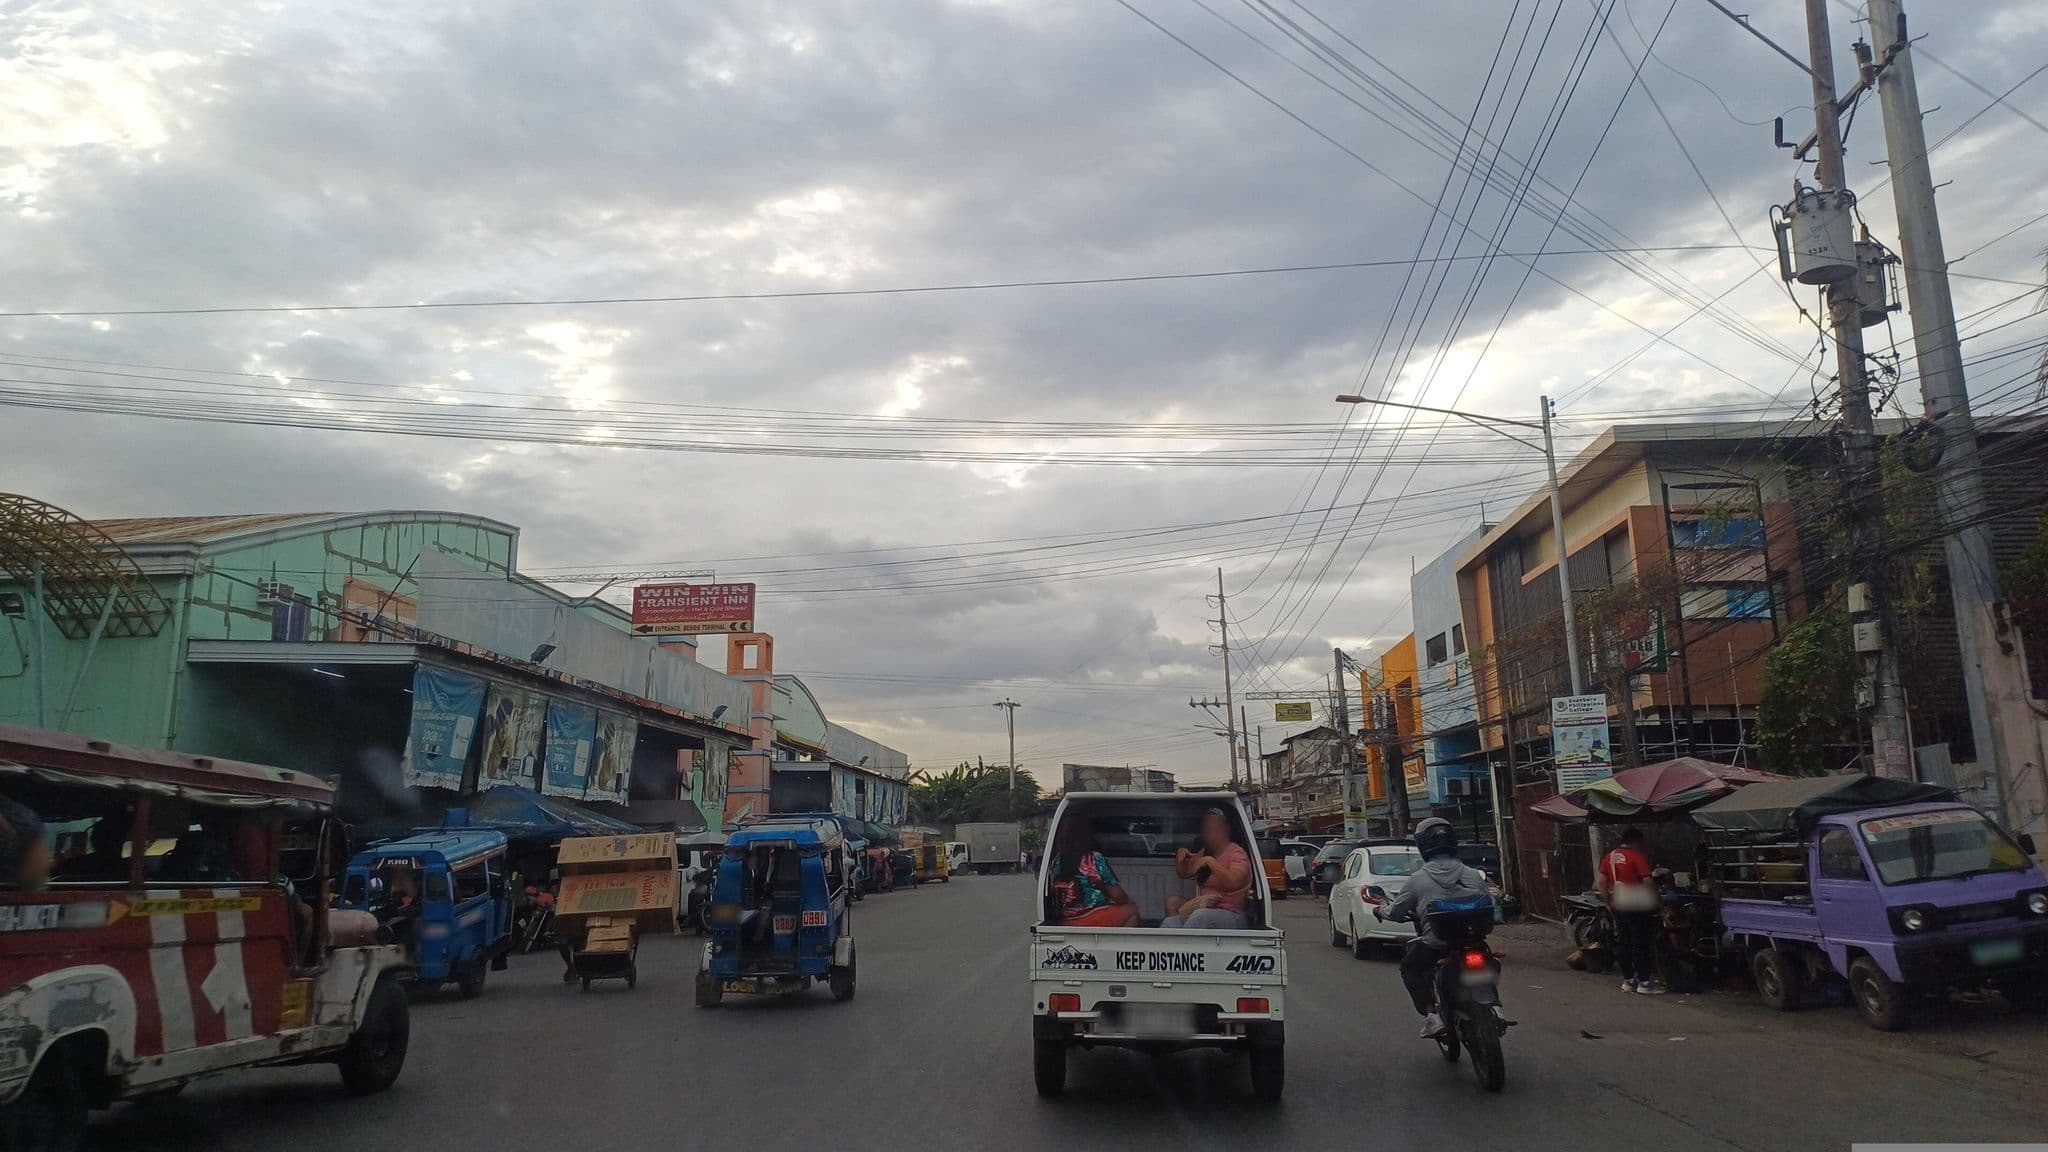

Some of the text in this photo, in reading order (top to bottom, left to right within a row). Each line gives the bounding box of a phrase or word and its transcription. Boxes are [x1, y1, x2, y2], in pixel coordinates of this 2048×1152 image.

[640, 586, 749, 598] WIN MIN
[638, 595, 749, 608] TRANSIENT INN
[654, 624, 680, 632] ENTRANCE
[1116, 951, 1205, 972] KEEP DISTANCE
[1226, 955, 1276, 972] 4WD
